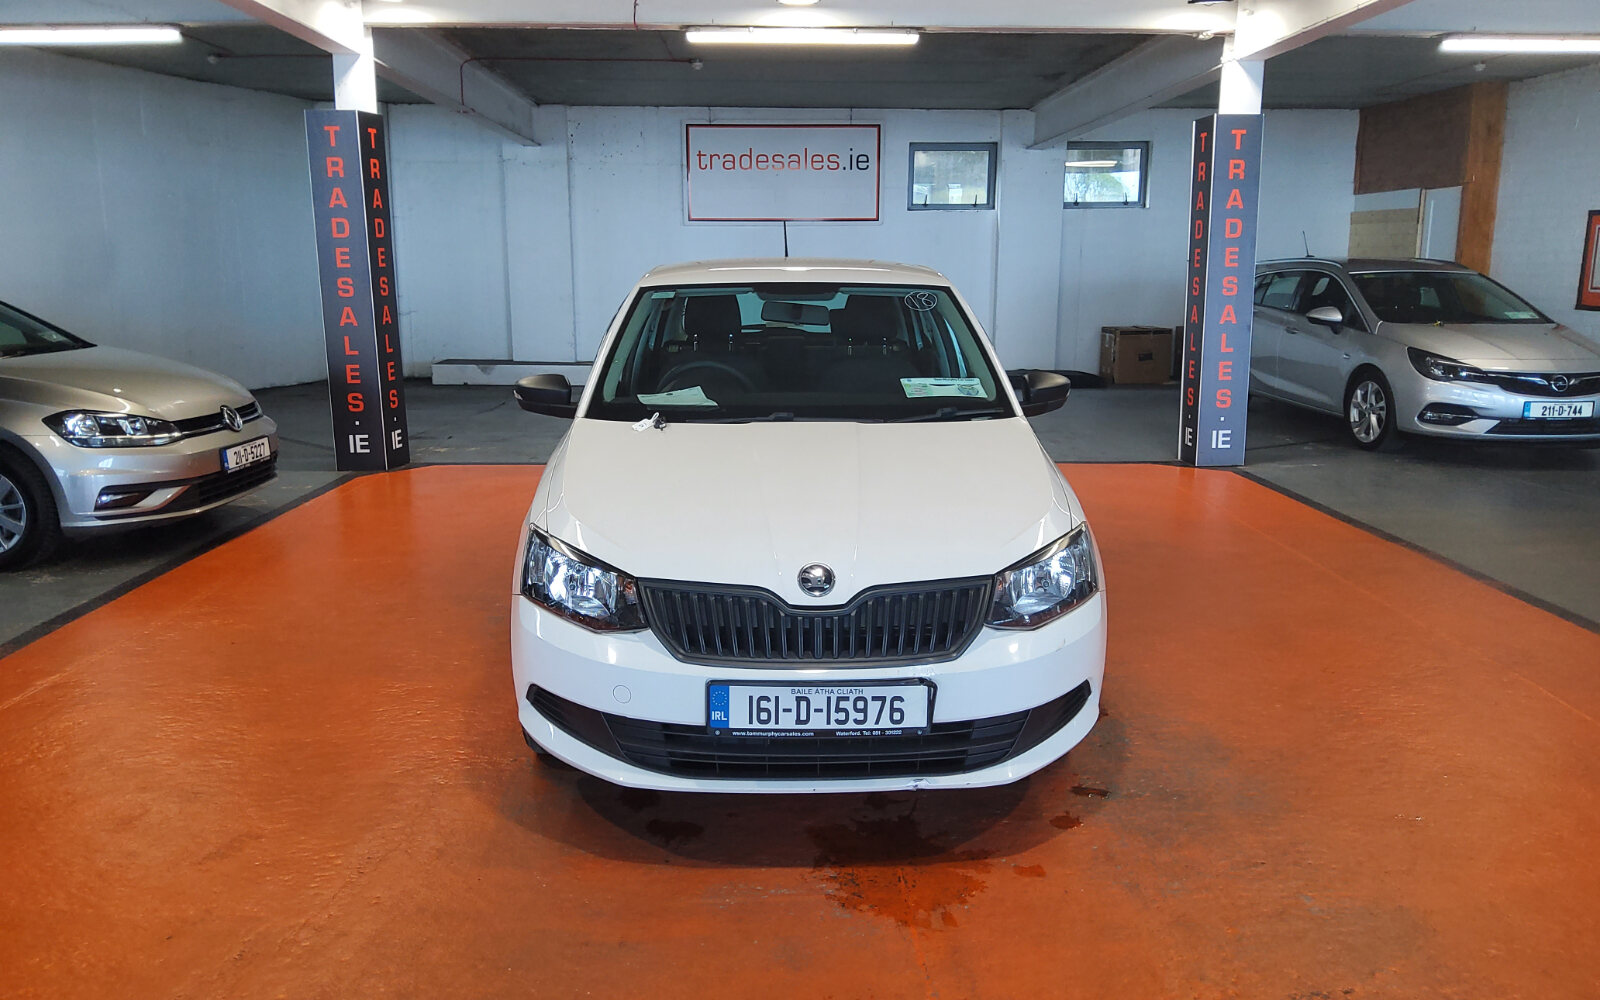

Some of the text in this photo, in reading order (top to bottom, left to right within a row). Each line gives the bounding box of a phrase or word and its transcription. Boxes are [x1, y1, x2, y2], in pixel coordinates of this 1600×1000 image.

[696, 147, 870, 171] tradesales.ie
[1541, 405, 1583, 416] 211-D-744
[711, 710, 728, 721] IRL
[748, 695, 905, 726] 161-D-15976
